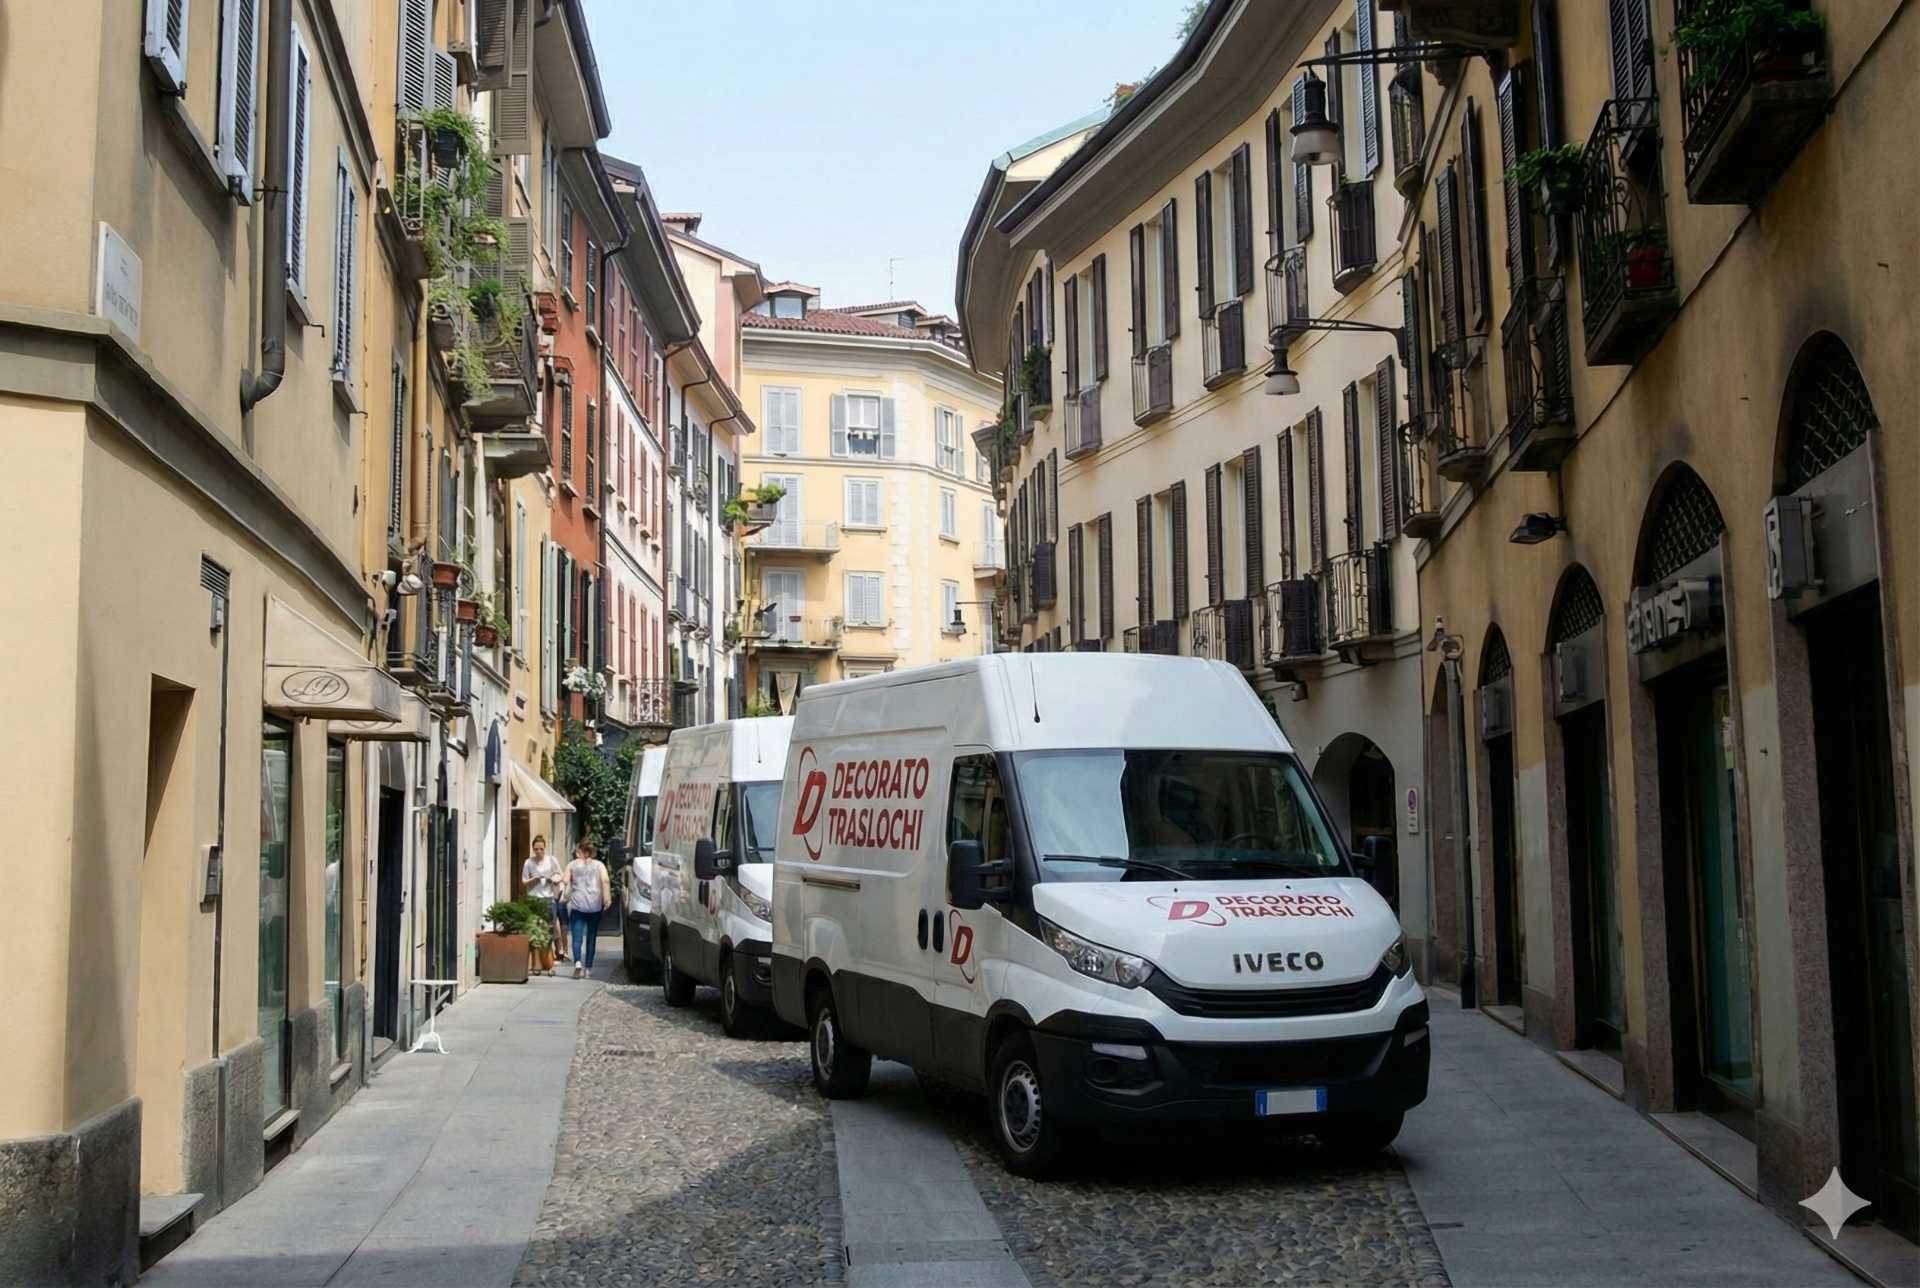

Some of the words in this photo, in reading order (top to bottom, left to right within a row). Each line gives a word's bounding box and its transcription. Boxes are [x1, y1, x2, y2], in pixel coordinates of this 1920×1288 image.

[831, 757, 930, 800] DECORATO
[829, 808, 925, 851] TRASLOCHI
[1215, 894, 1341, 906] DECORATO
[1225, 905, 1355, 918] TRASLOCHI
[1233, 951, 1324, 974] IVECO
